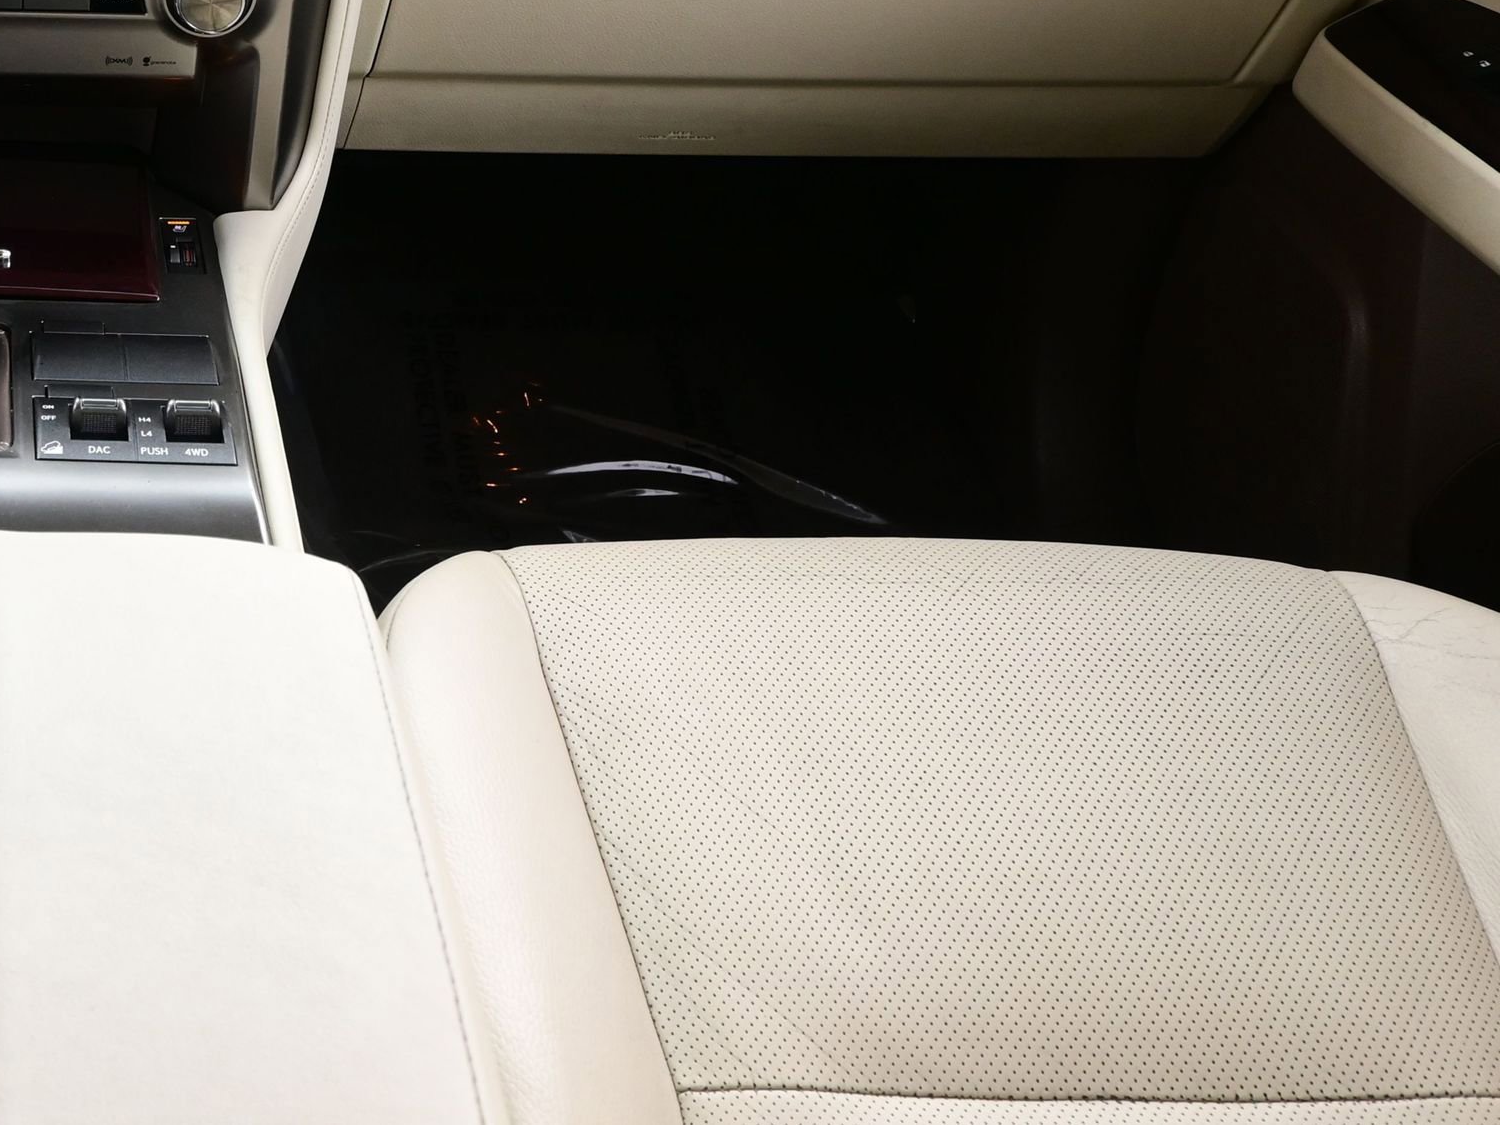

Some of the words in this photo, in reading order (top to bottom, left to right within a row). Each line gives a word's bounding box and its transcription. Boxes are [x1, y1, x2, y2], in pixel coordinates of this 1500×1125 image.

[88, 446, 111, 455] DAC
[140, 446, 169, 456] PUSH
[184, 448, 209, 457] 4WD
